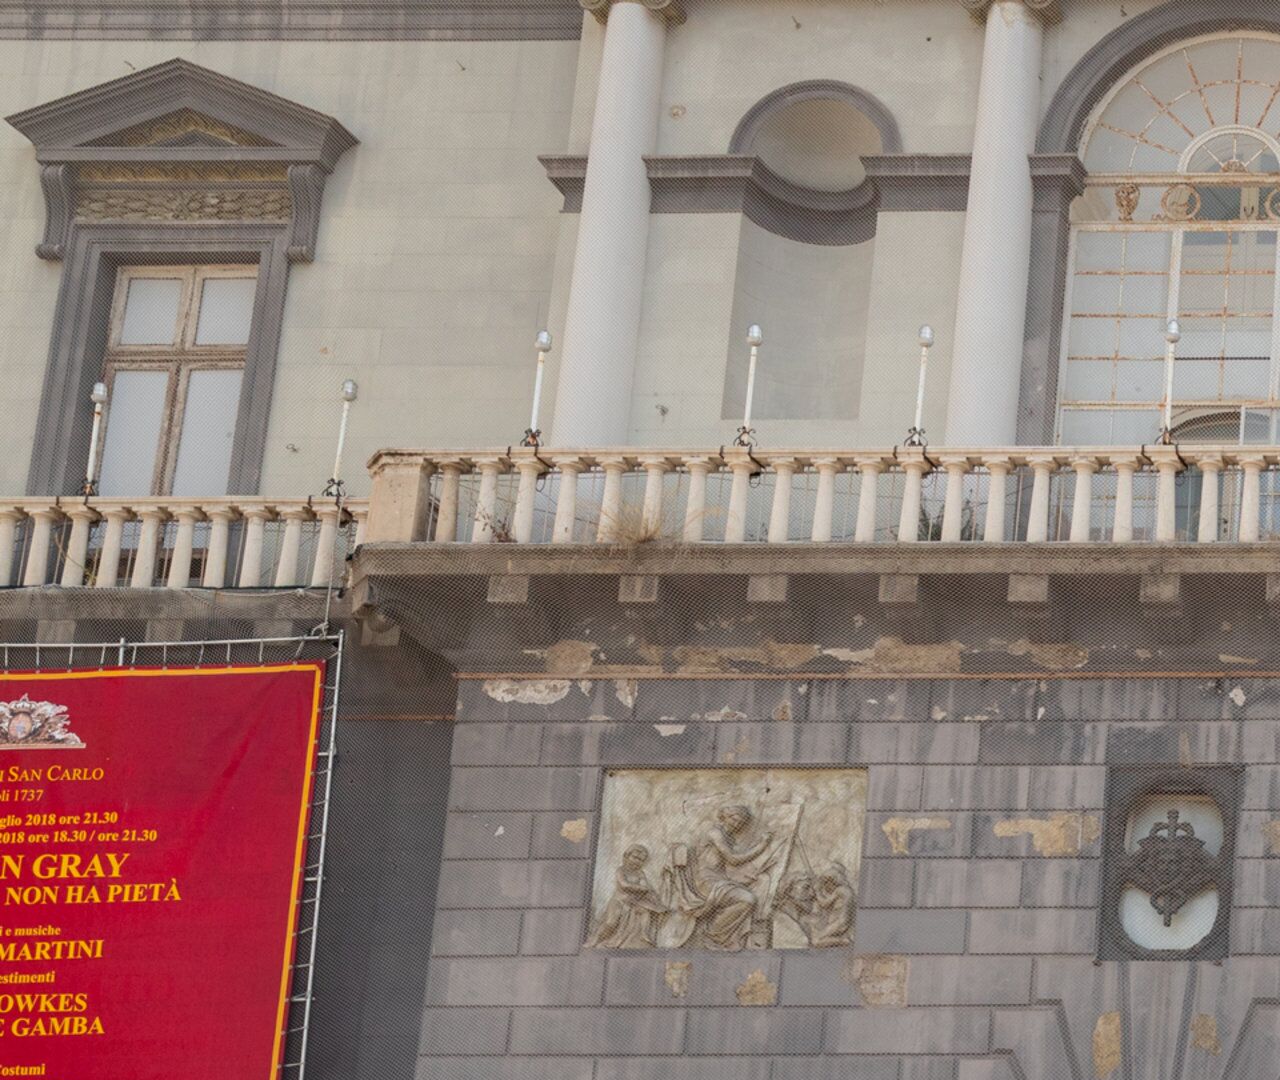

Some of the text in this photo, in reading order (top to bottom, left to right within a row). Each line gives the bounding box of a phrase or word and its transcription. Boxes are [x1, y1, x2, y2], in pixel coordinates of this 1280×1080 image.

[8, 766, 43, 782] SAN
[46, 765, 105, 782] CARLO
[0, 789, 44, 802] li 1737
[25, 813, 56, 826] 2018
[59, 816, 80, 825] ore
[83, 812, 119, 825] 21.30
[0, 829, 158, 844] 018 ore 18.30 / ore 21.30
[32, 853, 131, 879] GRAY
[5, 877, 182, 906] NON HA PIETÀ
[5, 928, 12, 937] e
[14, 924, 61, 937] musiche
[0, 939, 105, 961] MARTINI
[0, 993, 88, 1013] OWKES
[11, 1016, 105, 1037] GAMBA
[0, 1063, 46, 1077] ostumi
